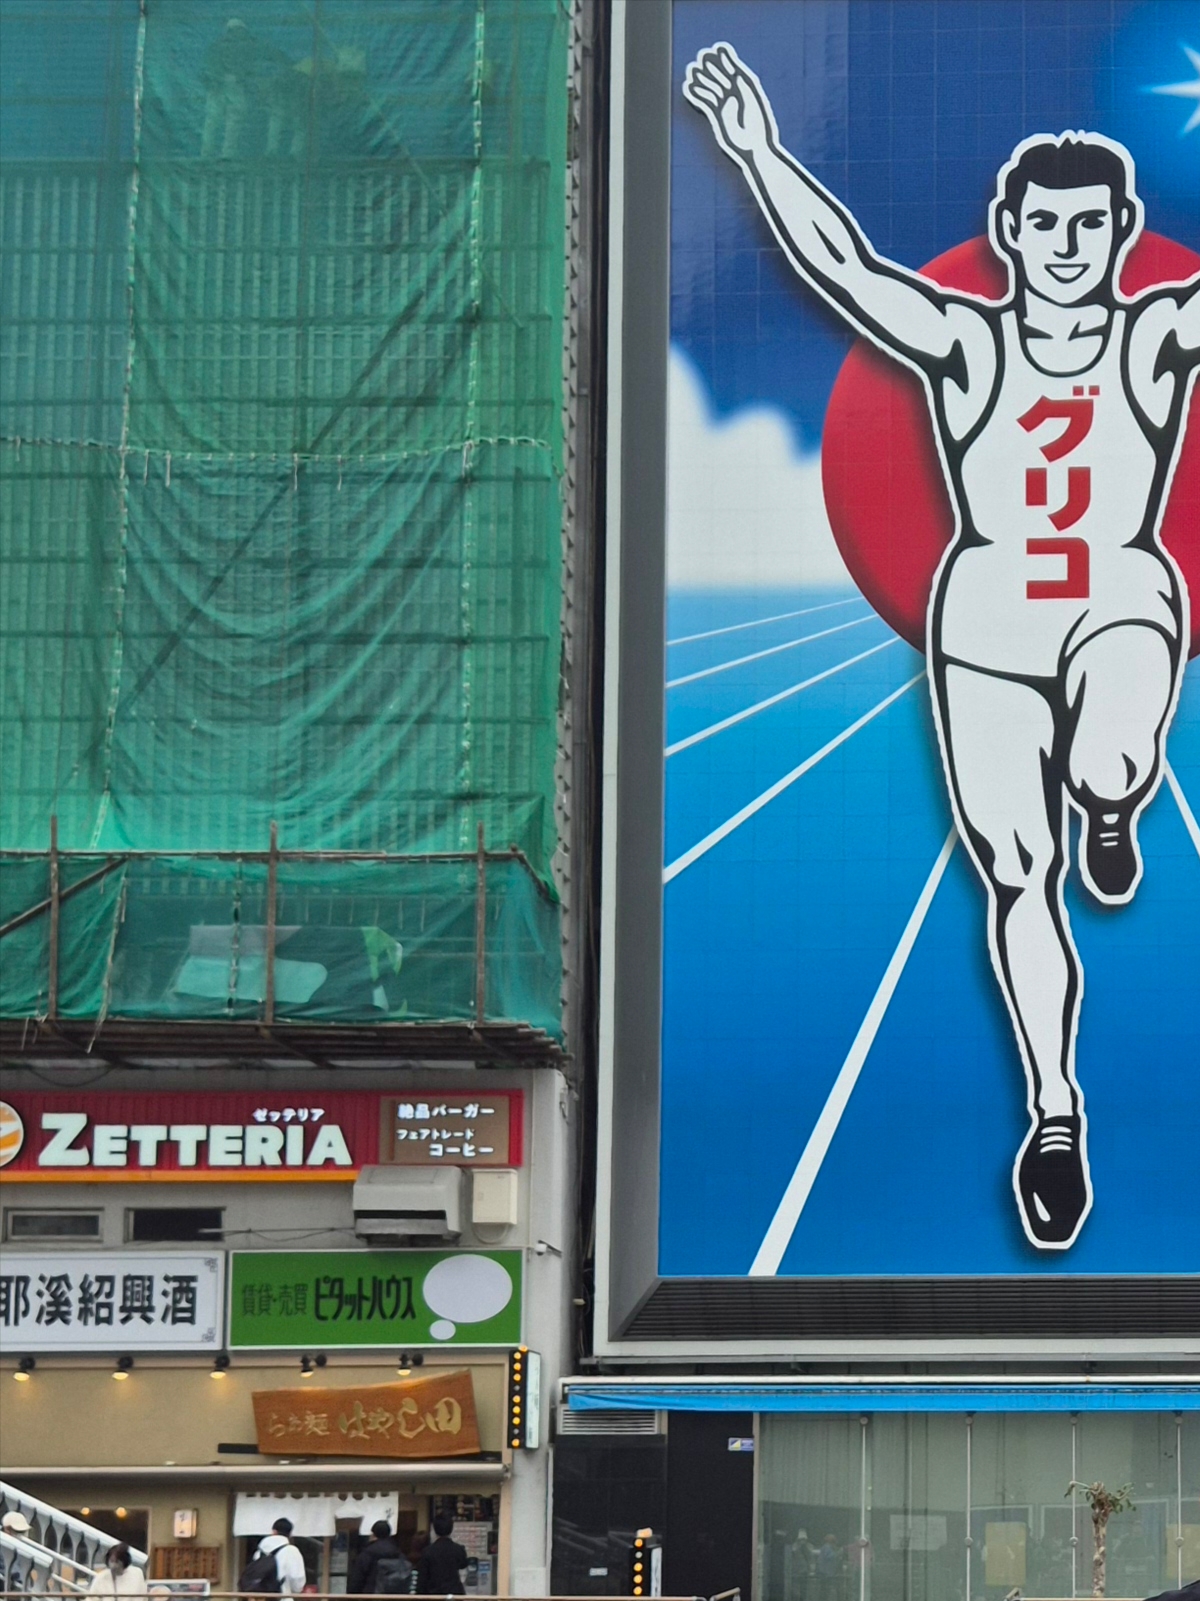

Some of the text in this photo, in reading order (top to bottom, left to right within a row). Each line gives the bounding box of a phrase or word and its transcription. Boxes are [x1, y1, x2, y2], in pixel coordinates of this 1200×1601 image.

[1016, 385, 1100, 600] グリコ
[252, 1108, 325, 1123] ゼッテリア
[397, 1103, 495, 1120] 絶品バーガー
[38, 1112, 353, 1166] ZETTERIA
[396, 1128, 475, 1140] フェアトレード
[429, 1143, 494, 1157] コーヒー
[314, 1275, 417, 1321] ピタットハウス
